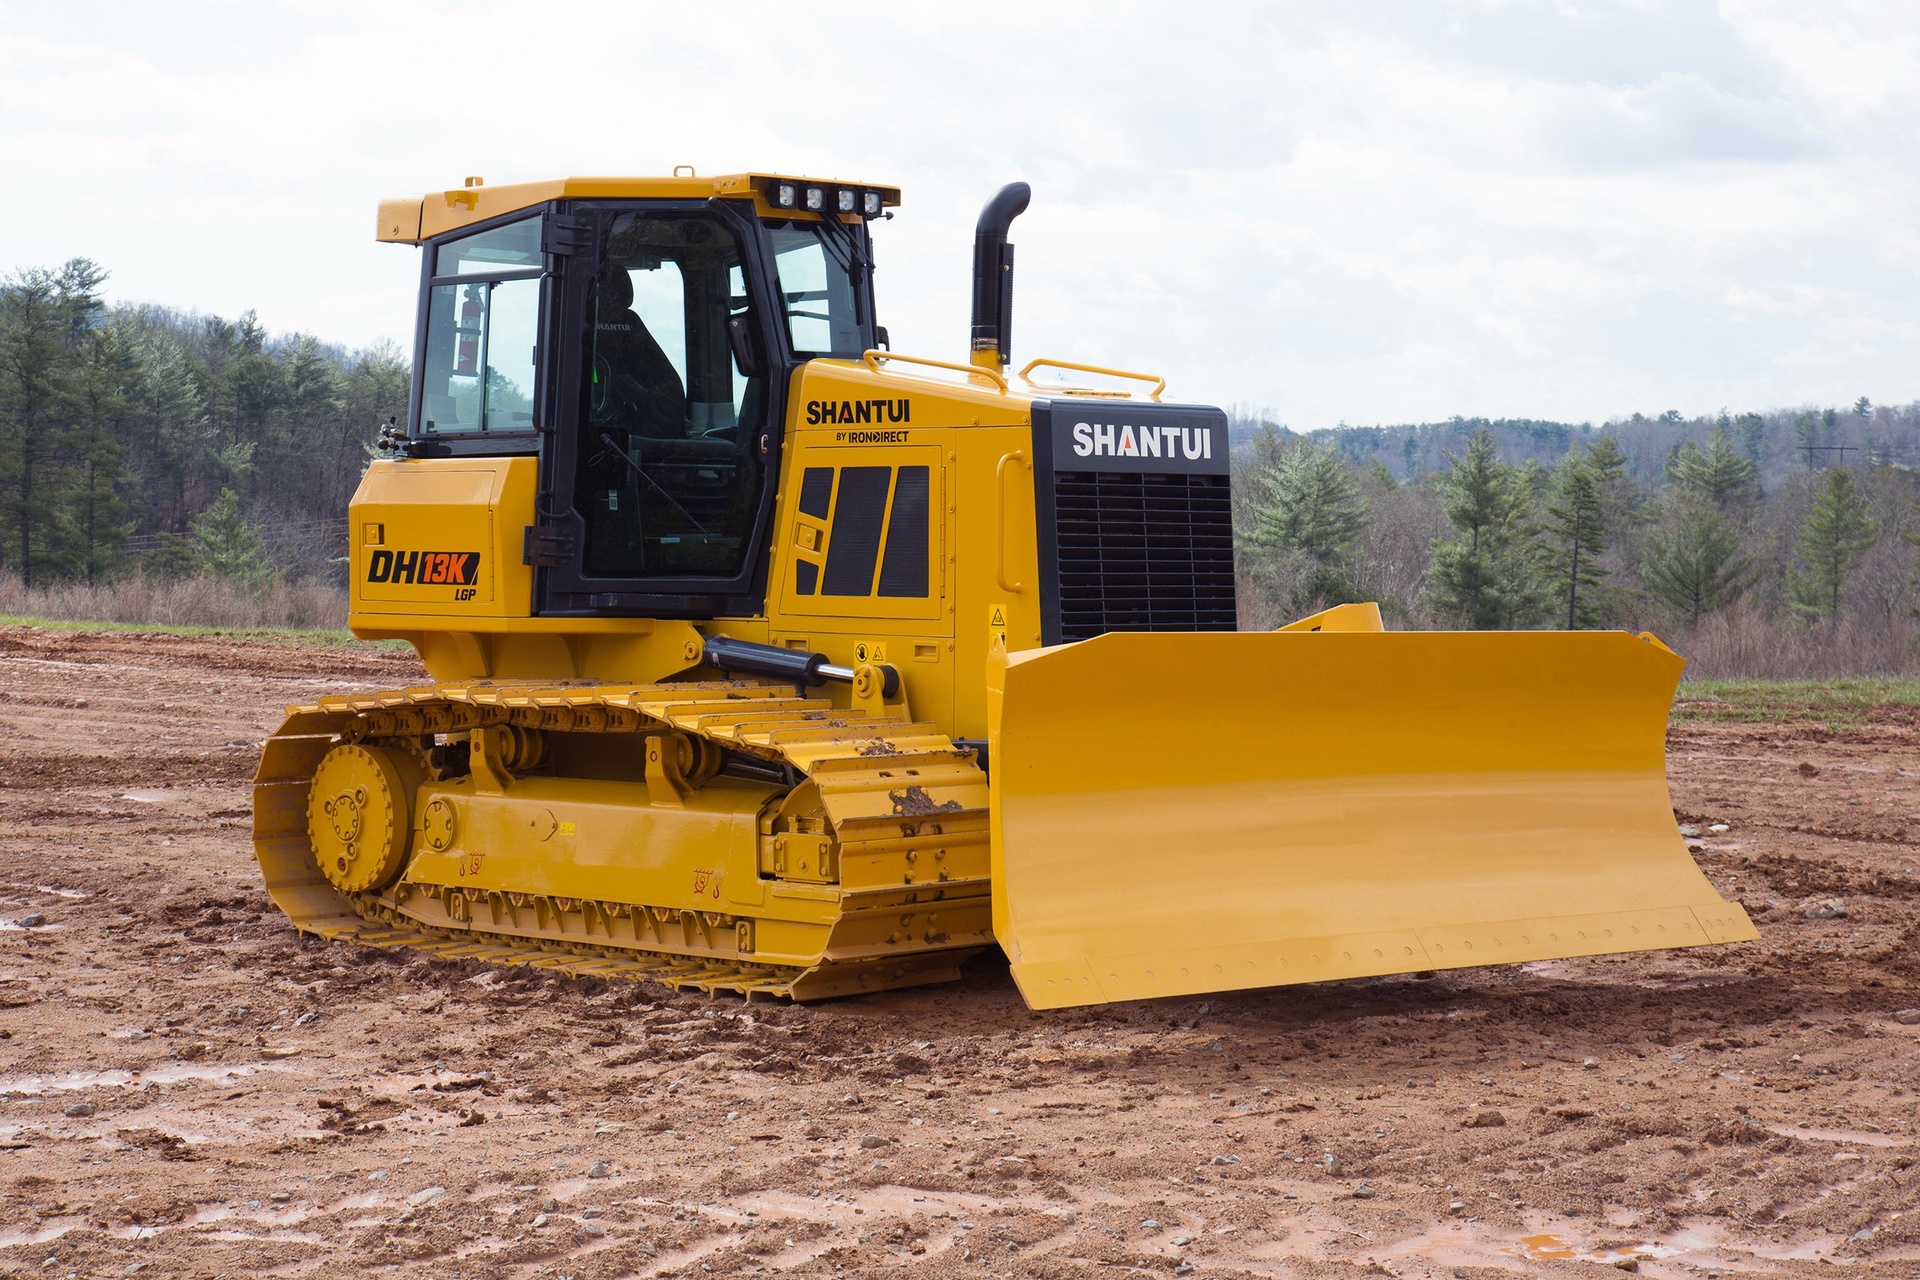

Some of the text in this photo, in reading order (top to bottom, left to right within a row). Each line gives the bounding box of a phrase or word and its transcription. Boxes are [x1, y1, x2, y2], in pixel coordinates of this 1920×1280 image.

[595, 322, 631, 332] HANTUI
[806, 399, 910, 425] SHANTUI
[836, 432, 846, 441] BY
[1073, 422, 1211, 460] SHANTUI
[367, 550, 469, 584] DH13K
[454, 589, 476, 601] LGP
